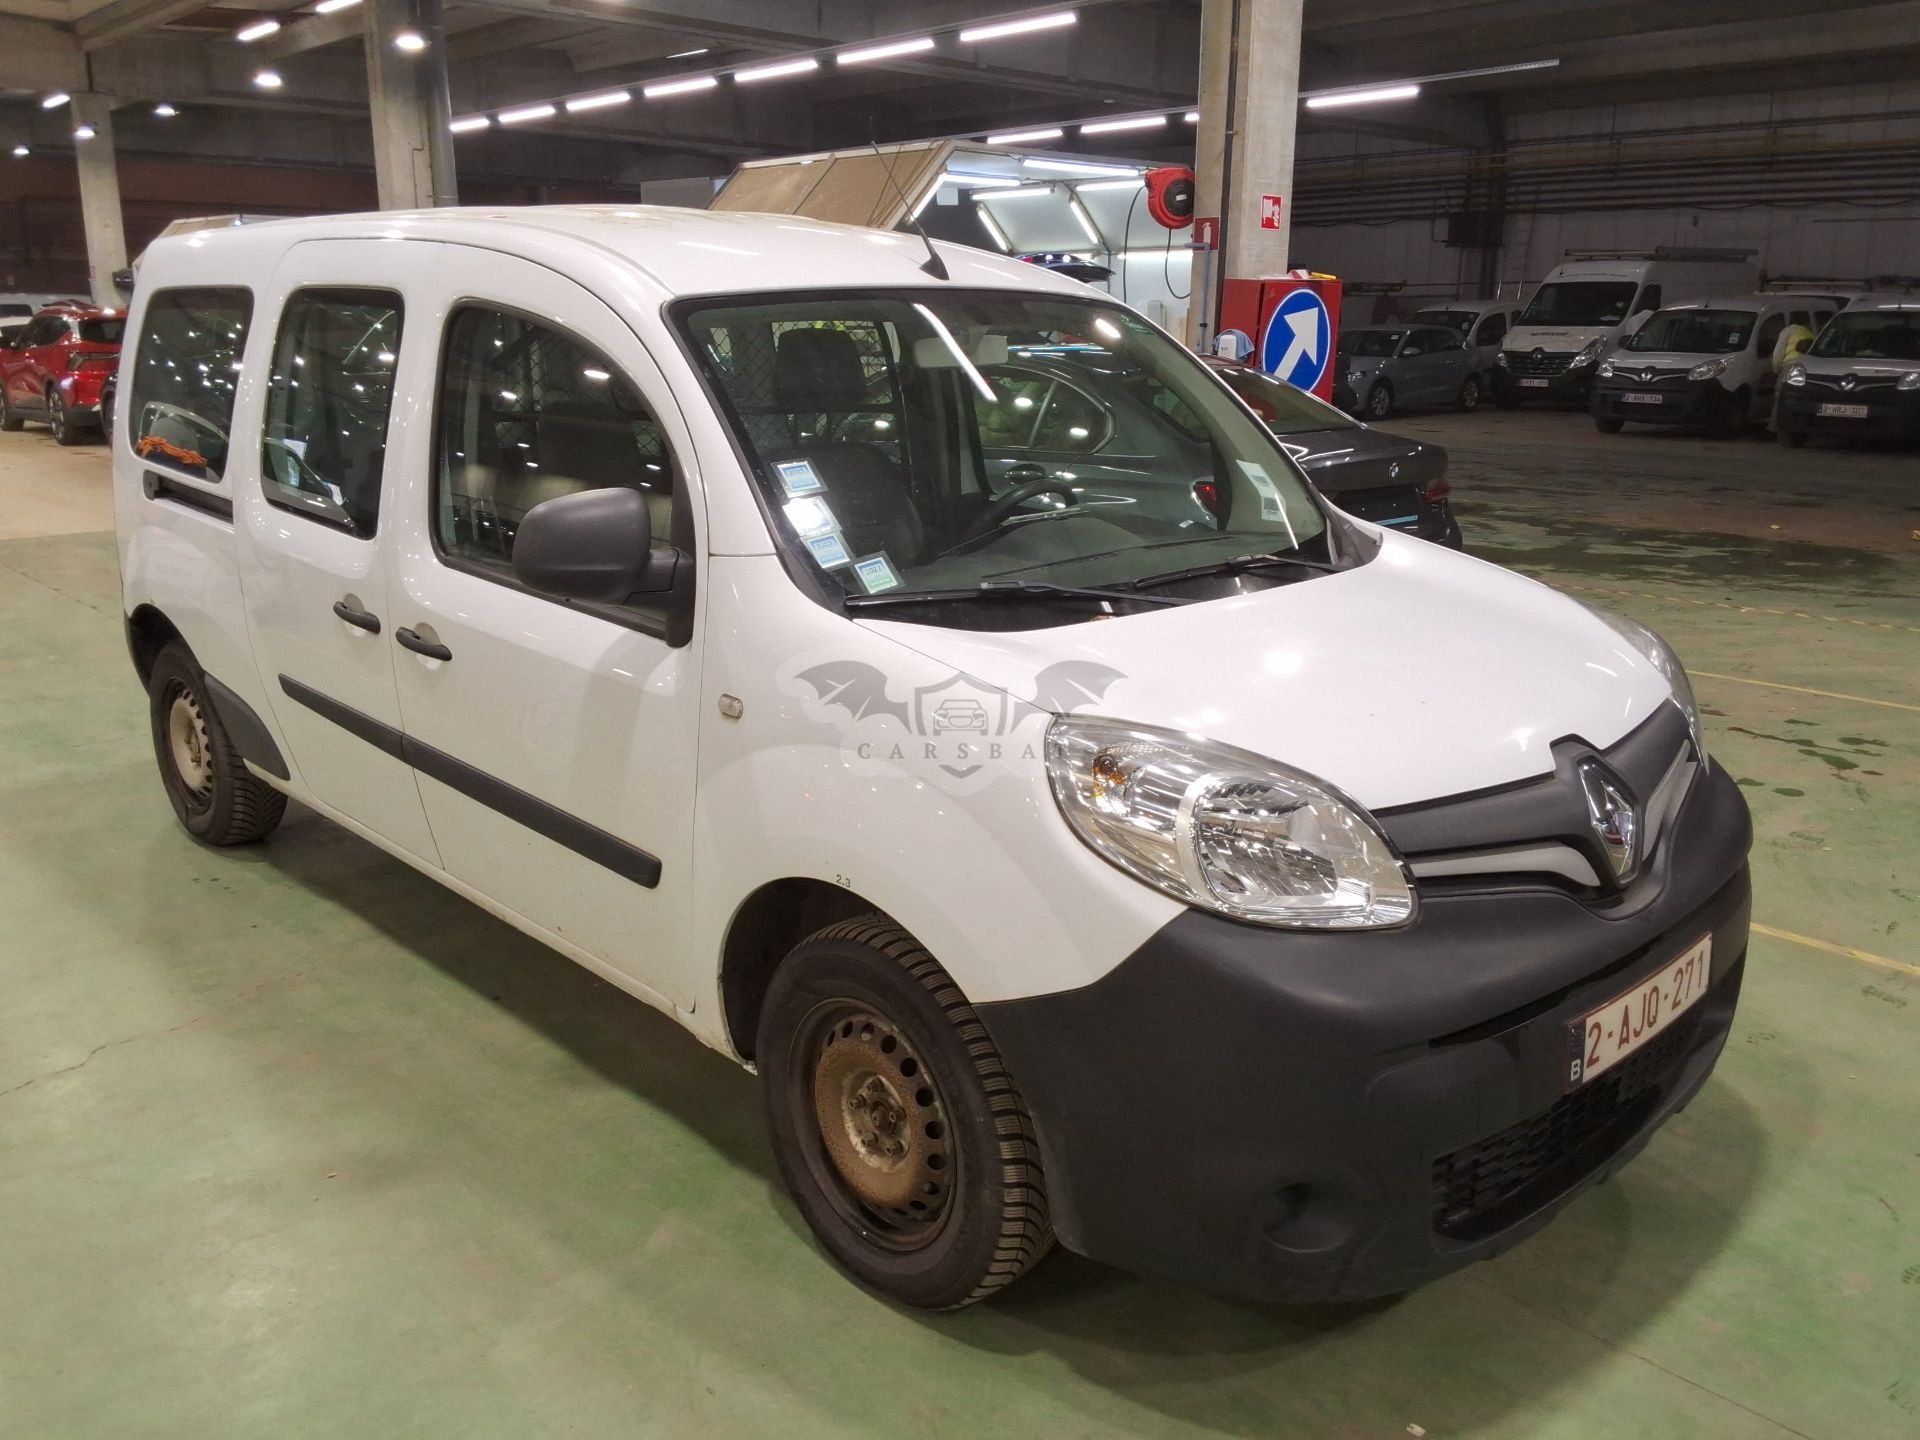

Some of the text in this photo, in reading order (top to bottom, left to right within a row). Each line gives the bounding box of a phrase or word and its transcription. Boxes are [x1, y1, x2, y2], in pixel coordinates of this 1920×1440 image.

[836, 873, 851, 888] 2.3
[1586, 949, 1704, 1069] 2-AJQ-271
[1570, 1058, 1581, 1082] B
